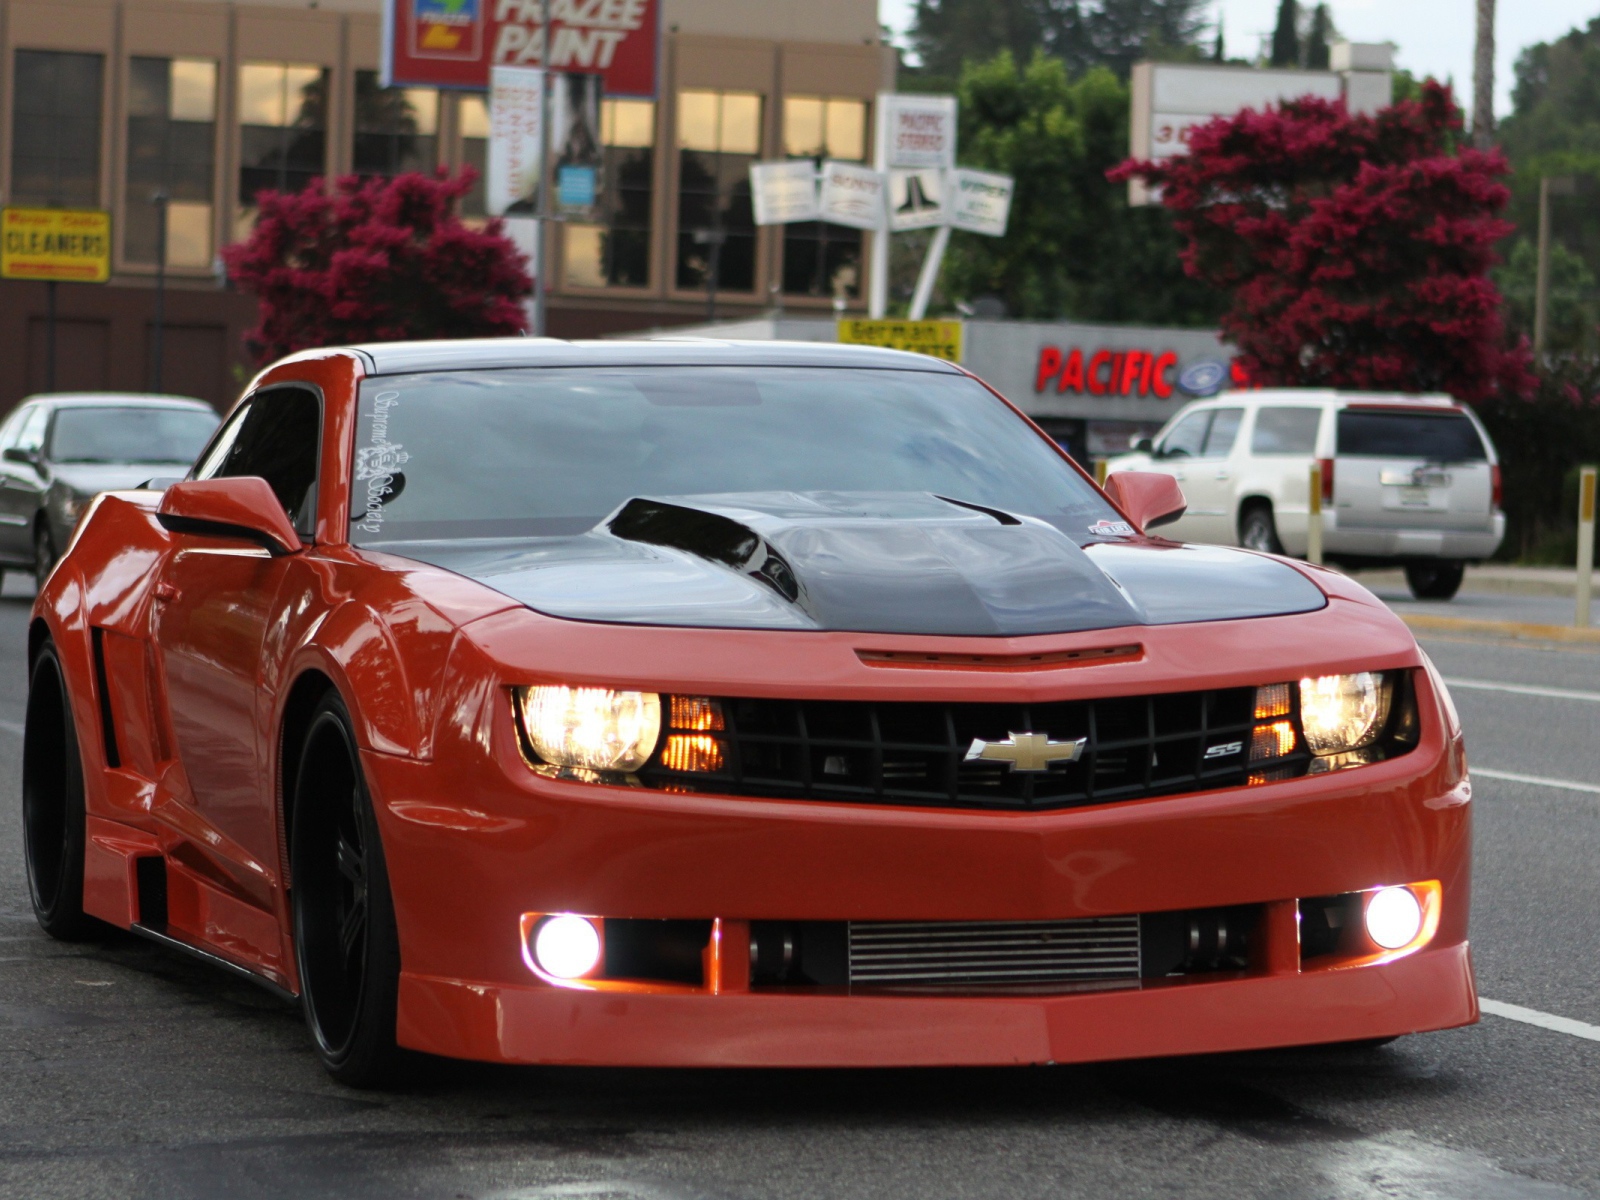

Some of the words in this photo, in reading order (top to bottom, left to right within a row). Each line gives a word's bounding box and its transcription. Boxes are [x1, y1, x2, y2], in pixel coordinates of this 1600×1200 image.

[494, 0, 647, 30] FRAZEE
[494, 25, 627, 68] PAINT
[900, 113, 944, 132] PACIFIC
[896, 133, 944, 152] STEREO
[6, 230, 106, 258] CLEANERS
[851, 321, 937, 341] German
[1034, 344, 1178, 398] PACIFIC
[365, 391, 400, 446] Supreme
[357, 475, 394, 533] Society
[1203, 741, 1243, 759] SS
